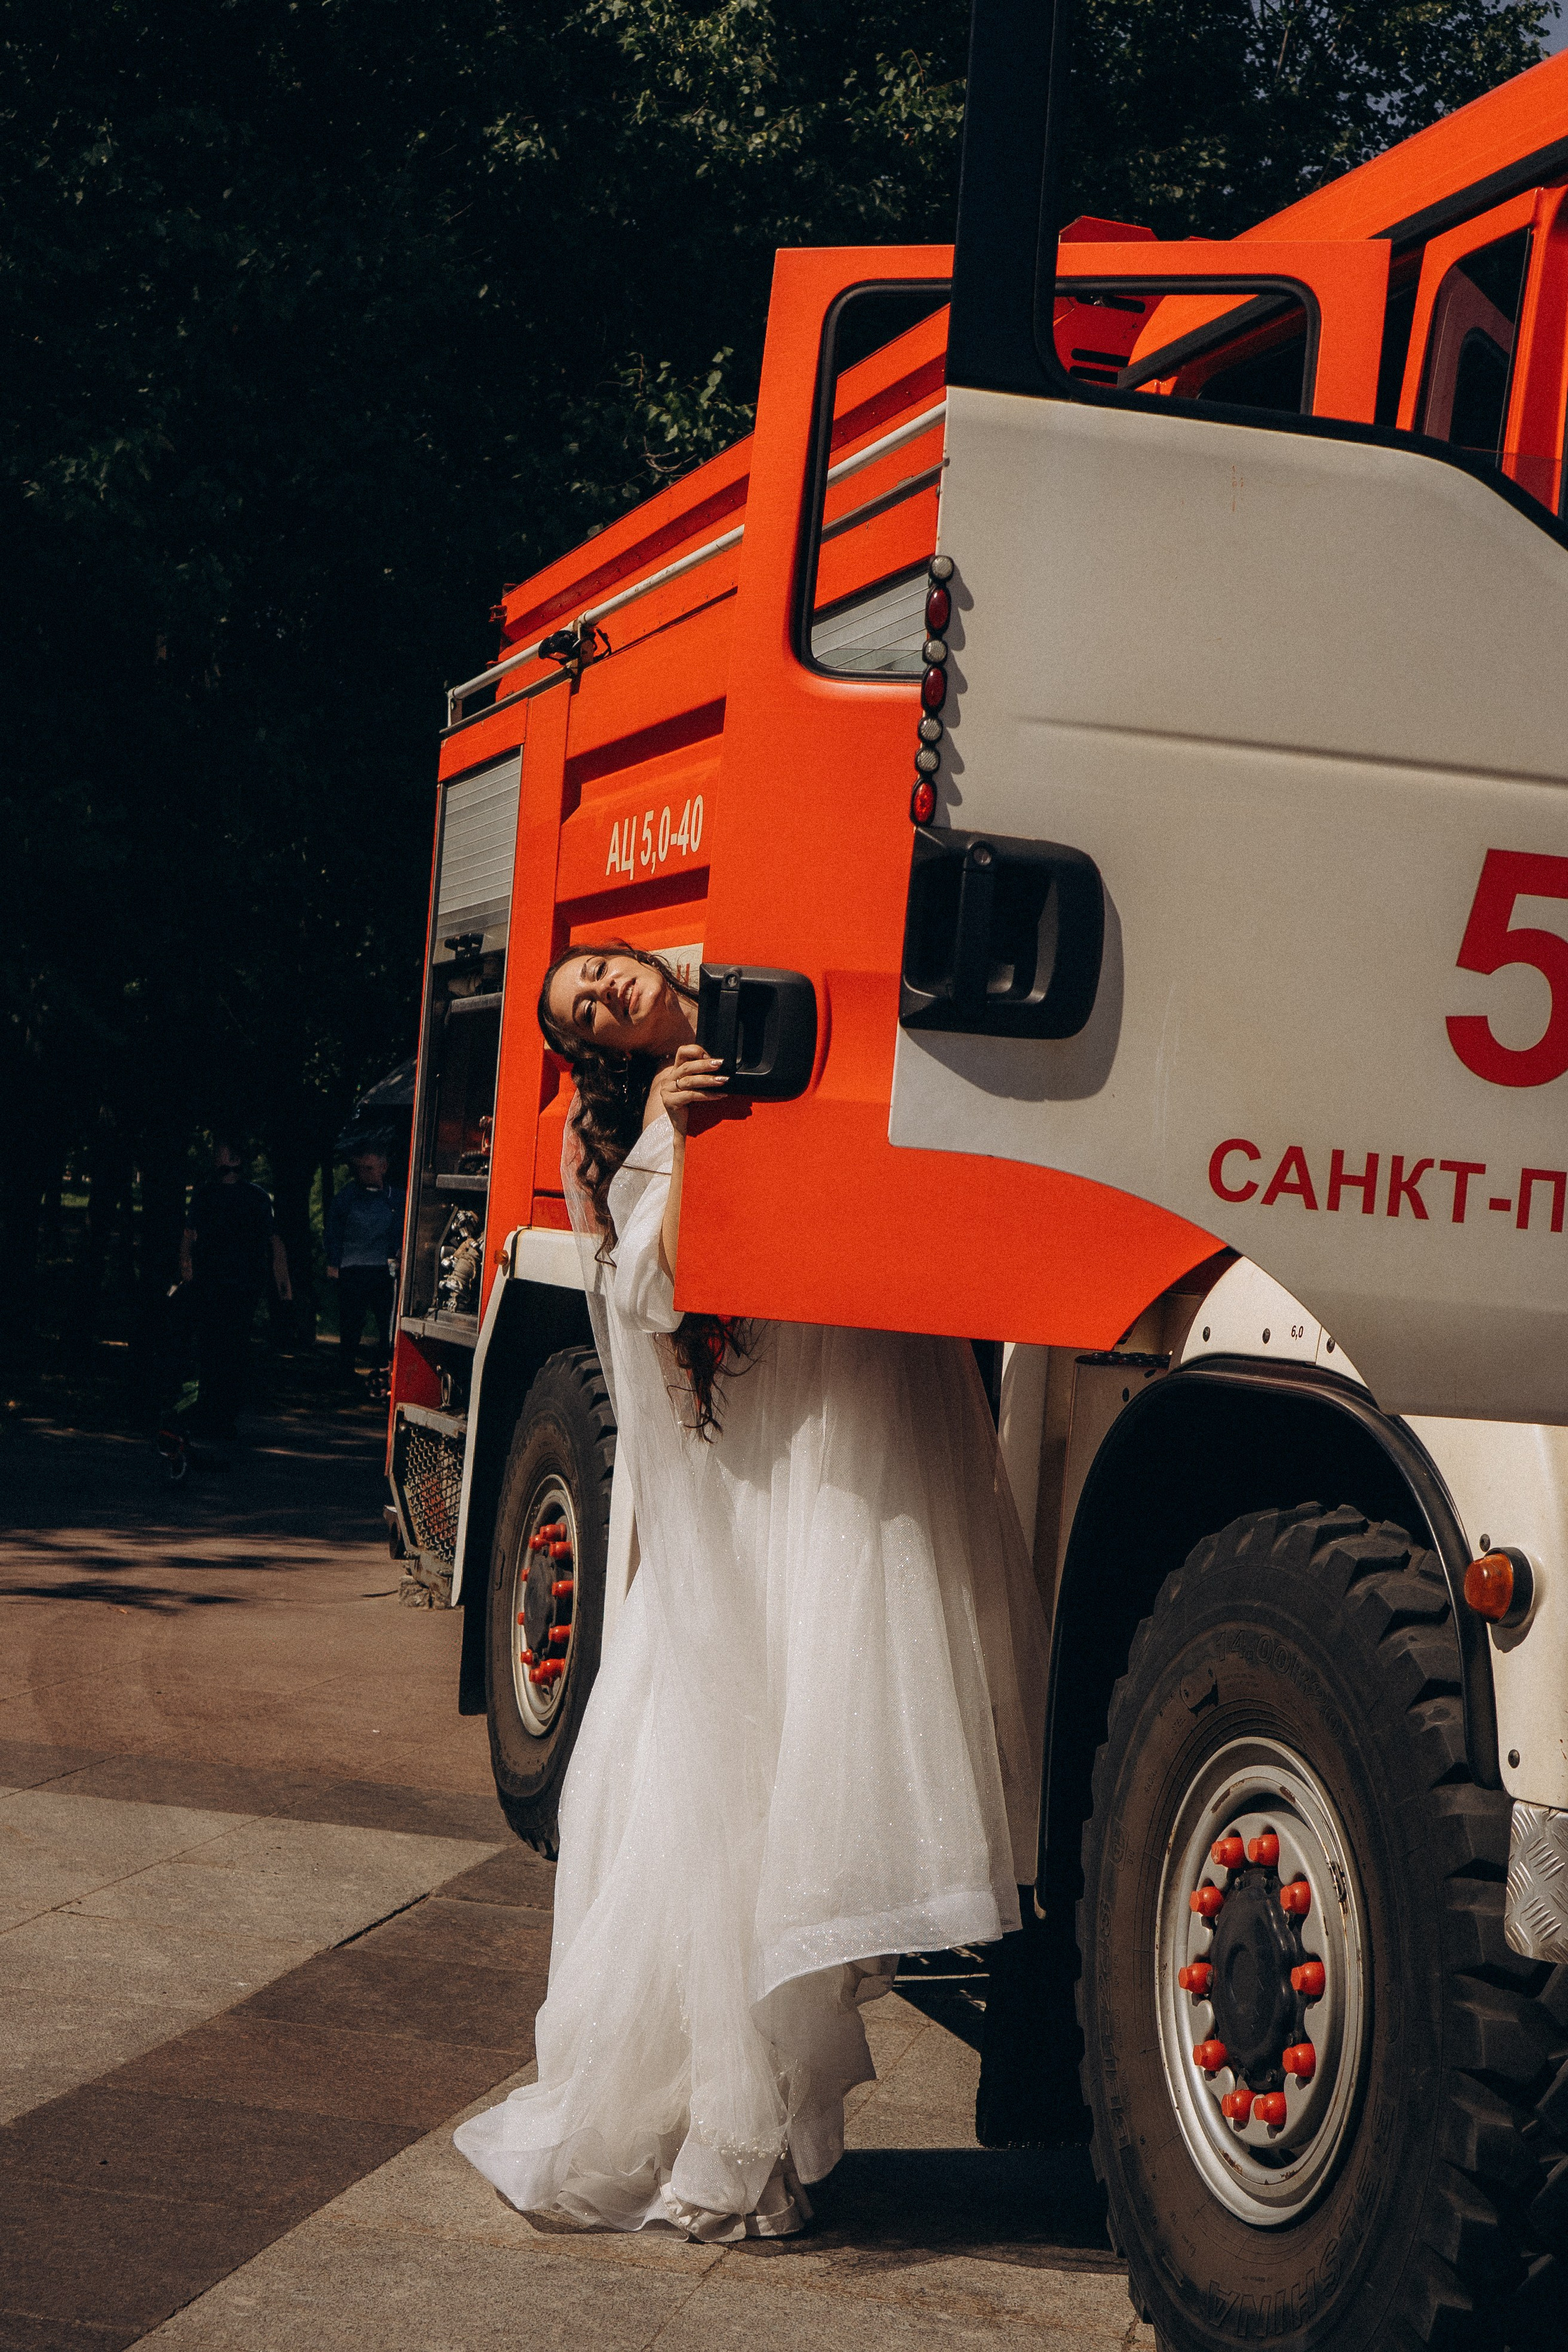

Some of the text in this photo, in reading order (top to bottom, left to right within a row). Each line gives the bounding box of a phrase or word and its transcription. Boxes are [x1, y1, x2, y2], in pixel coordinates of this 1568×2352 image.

[606, 795, 703, 880] АЦ 5,0-40
[1446, 849, 1568, 1088] 5
[1208, 1139, 1567, 1233] САНКТ-П
[1291, 1325, 1304, 1340] 6,0
